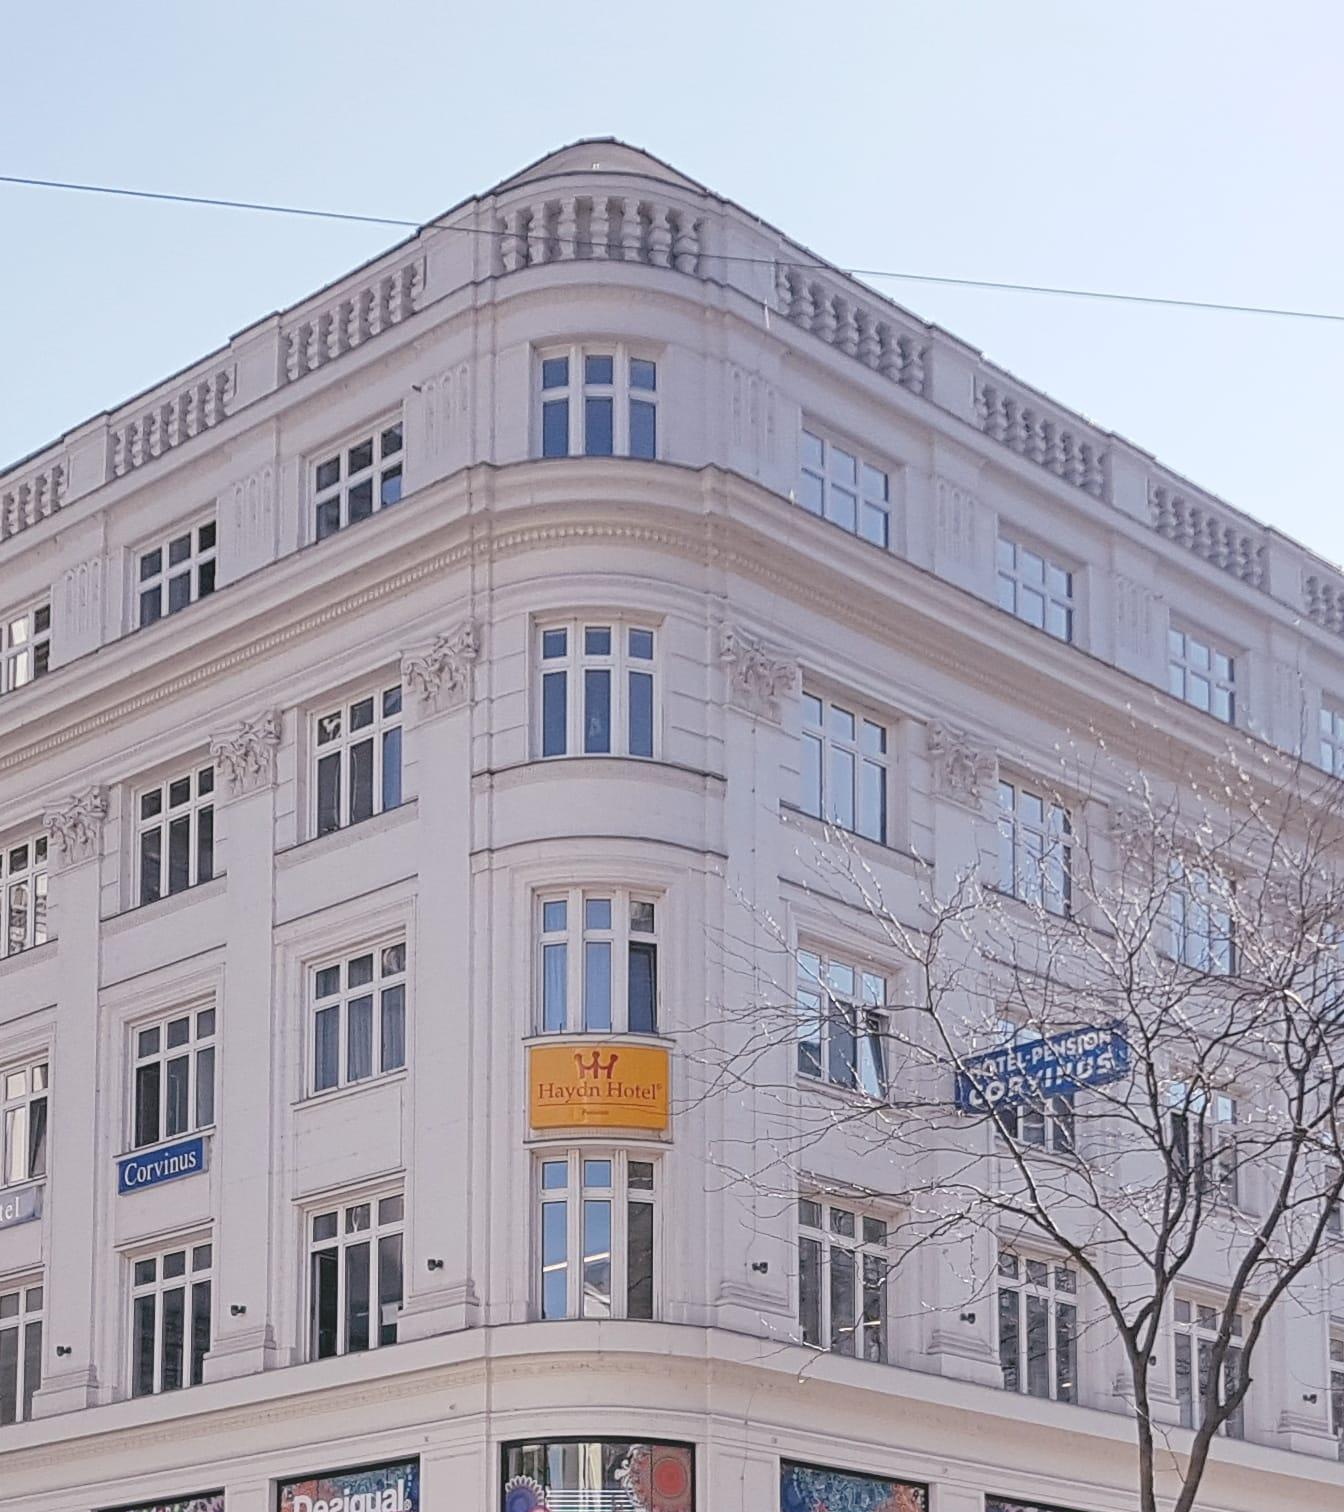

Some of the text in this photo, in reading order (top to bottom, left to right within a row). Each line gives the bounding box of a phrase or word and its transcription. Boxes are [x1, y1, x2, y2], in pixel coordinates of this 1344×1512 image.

[972, 1032, 1112, 1077] OTEL-PENSION
[538, 1082, 600, 1104] Haydn
[124, 1150, 197, 1187] Corvinus
